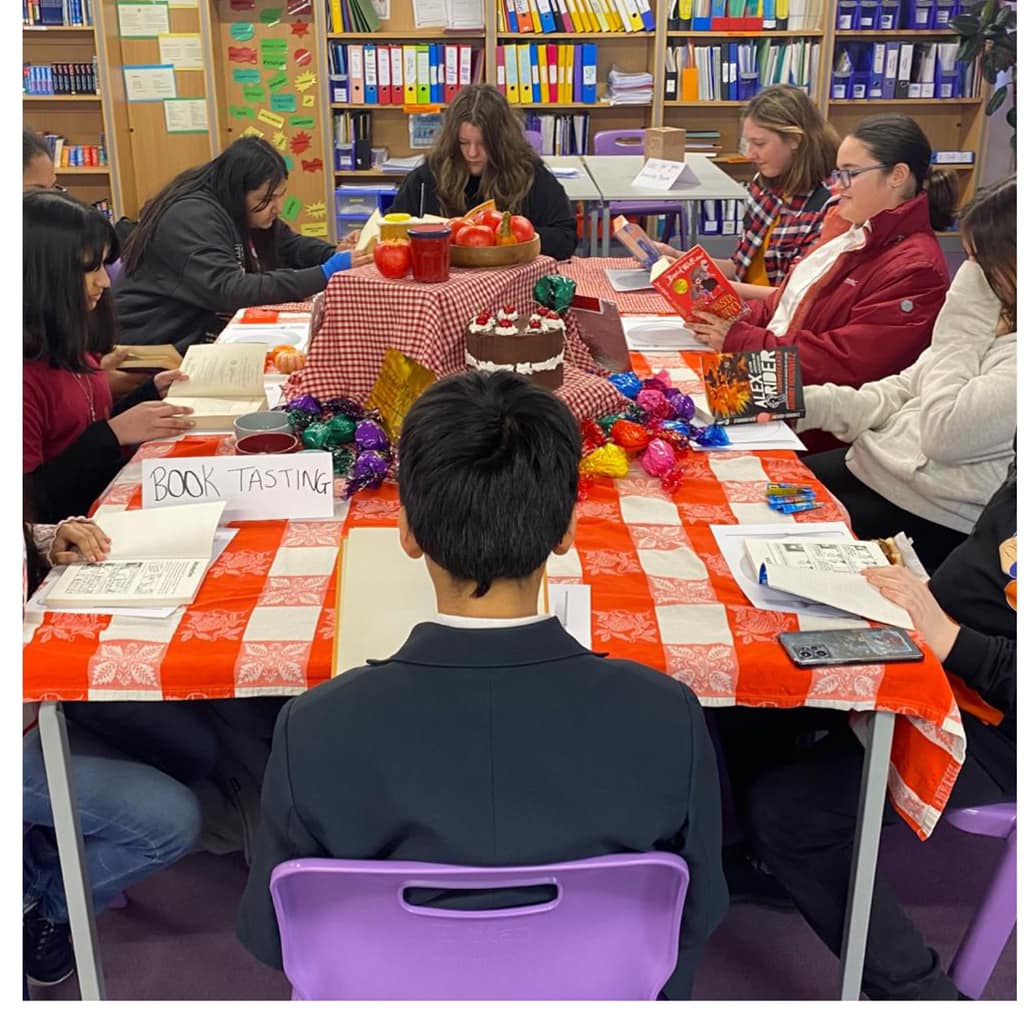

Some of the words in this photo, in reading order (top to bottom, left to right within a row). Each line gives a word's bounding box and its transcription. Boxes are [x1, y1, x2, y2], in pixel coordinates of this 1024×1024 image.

[748, 373, 768, 409] ALEX
[760, 350, 779, 396] RIDER
[150, 464, 221, 502] BOOK
[227, 466, 332, 495] TASTING
